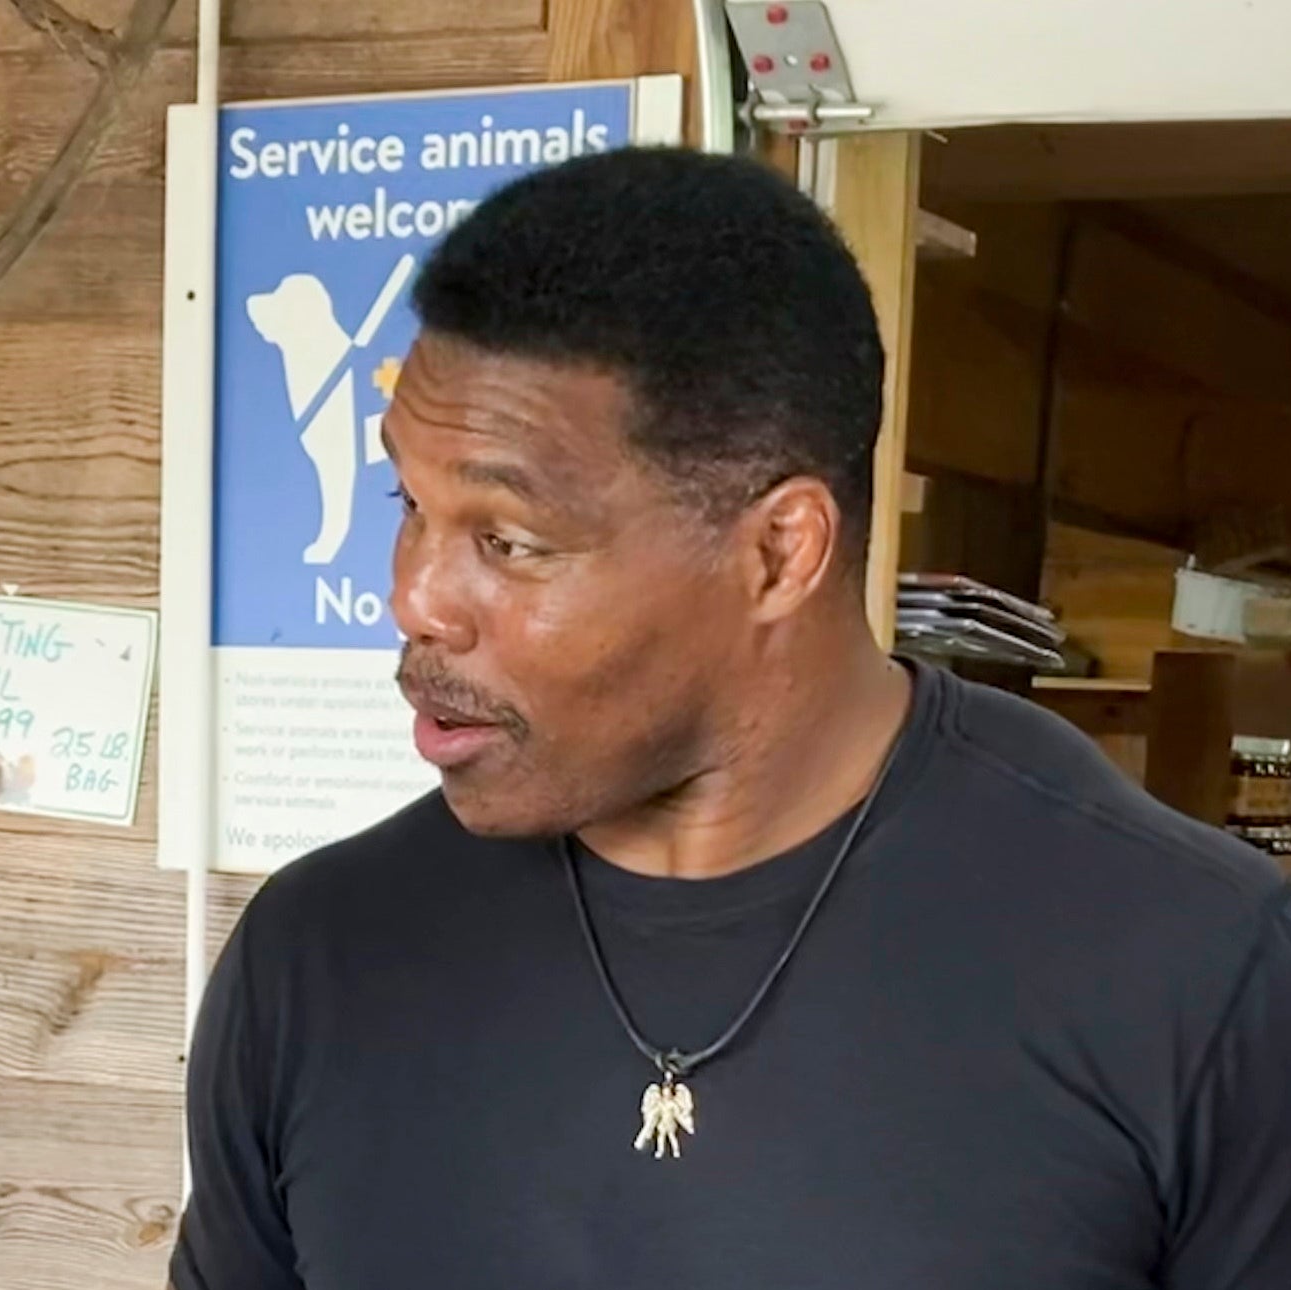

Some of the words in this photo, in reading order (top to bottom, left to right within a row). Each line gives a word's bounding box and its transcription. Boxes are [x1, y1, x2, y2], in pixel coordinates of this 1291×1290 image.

[229, 122, 405, 179] Service
[421, 108, 608, 169] animals
[315, 576, 382, 626] No
[66, 763, 119, 793] BAG
[225, 825, 257, 849] We
